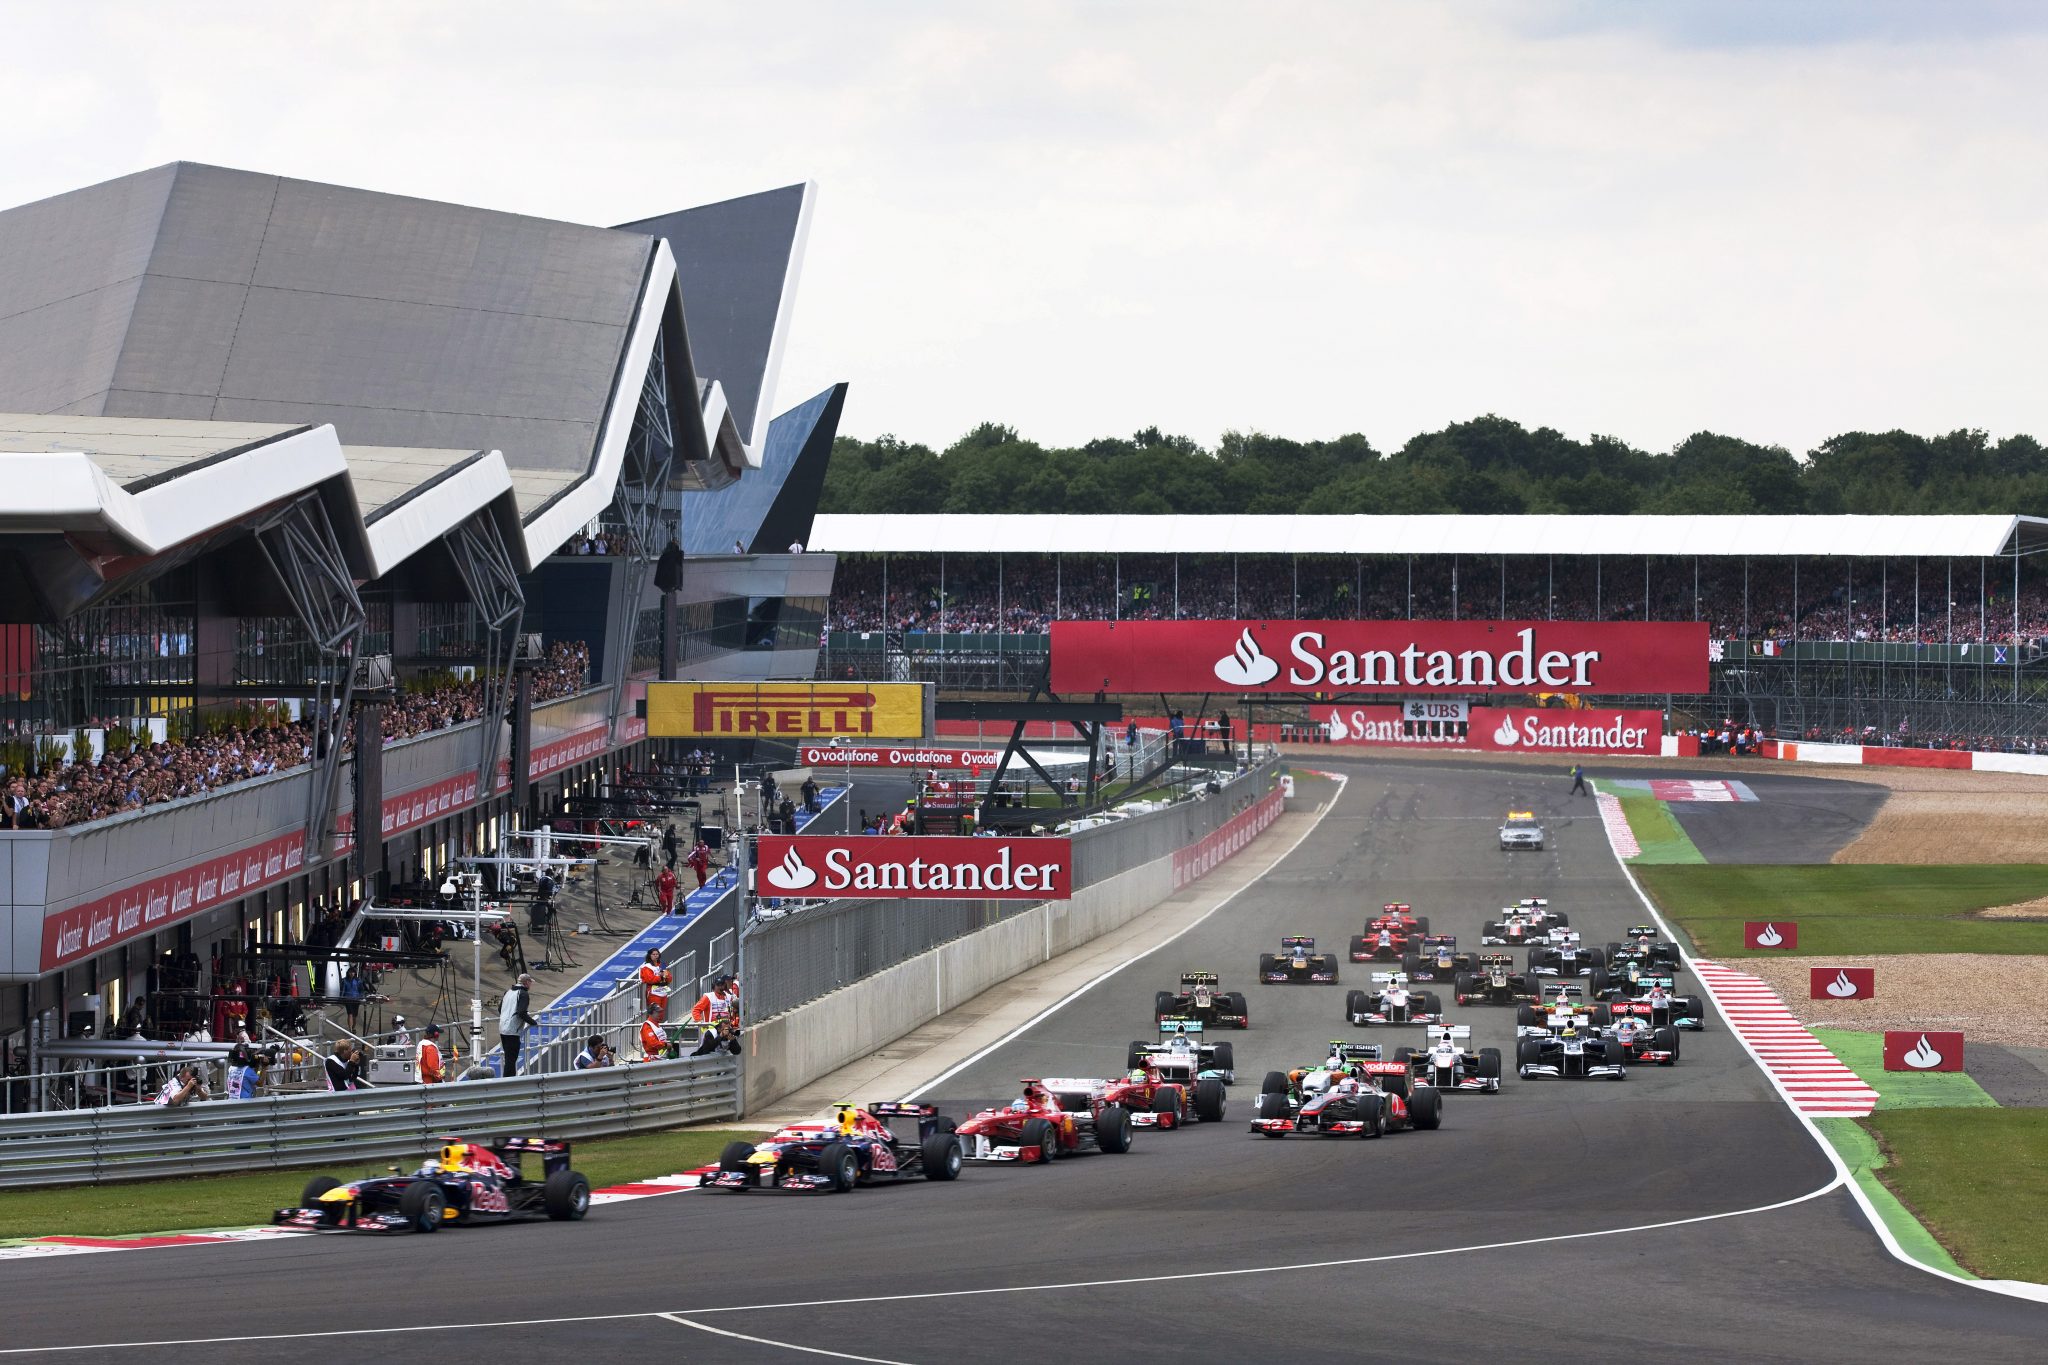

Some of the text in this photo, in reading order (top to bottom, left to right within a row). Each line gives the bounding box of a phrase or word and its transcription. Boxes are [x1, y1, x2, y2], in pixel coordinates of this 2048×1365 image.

[1290, 627, 1599, 687] Santander
[693, 691, 876, 733] PIRELLI
[1426, 703, 1460, 718] UBS
[1523, 715, 1648, 749] Santander
[821, 749, 879, 763] vodafone
[901, 750, 953, 764] vodafone
[825, 846, 1063, 892] Santander
[61, 912, 84, 956] Santander
[91, 901, 114, 945] Santander
[121, 891, 142, 932] Santander
[147, 881, 169, 922] Santander
